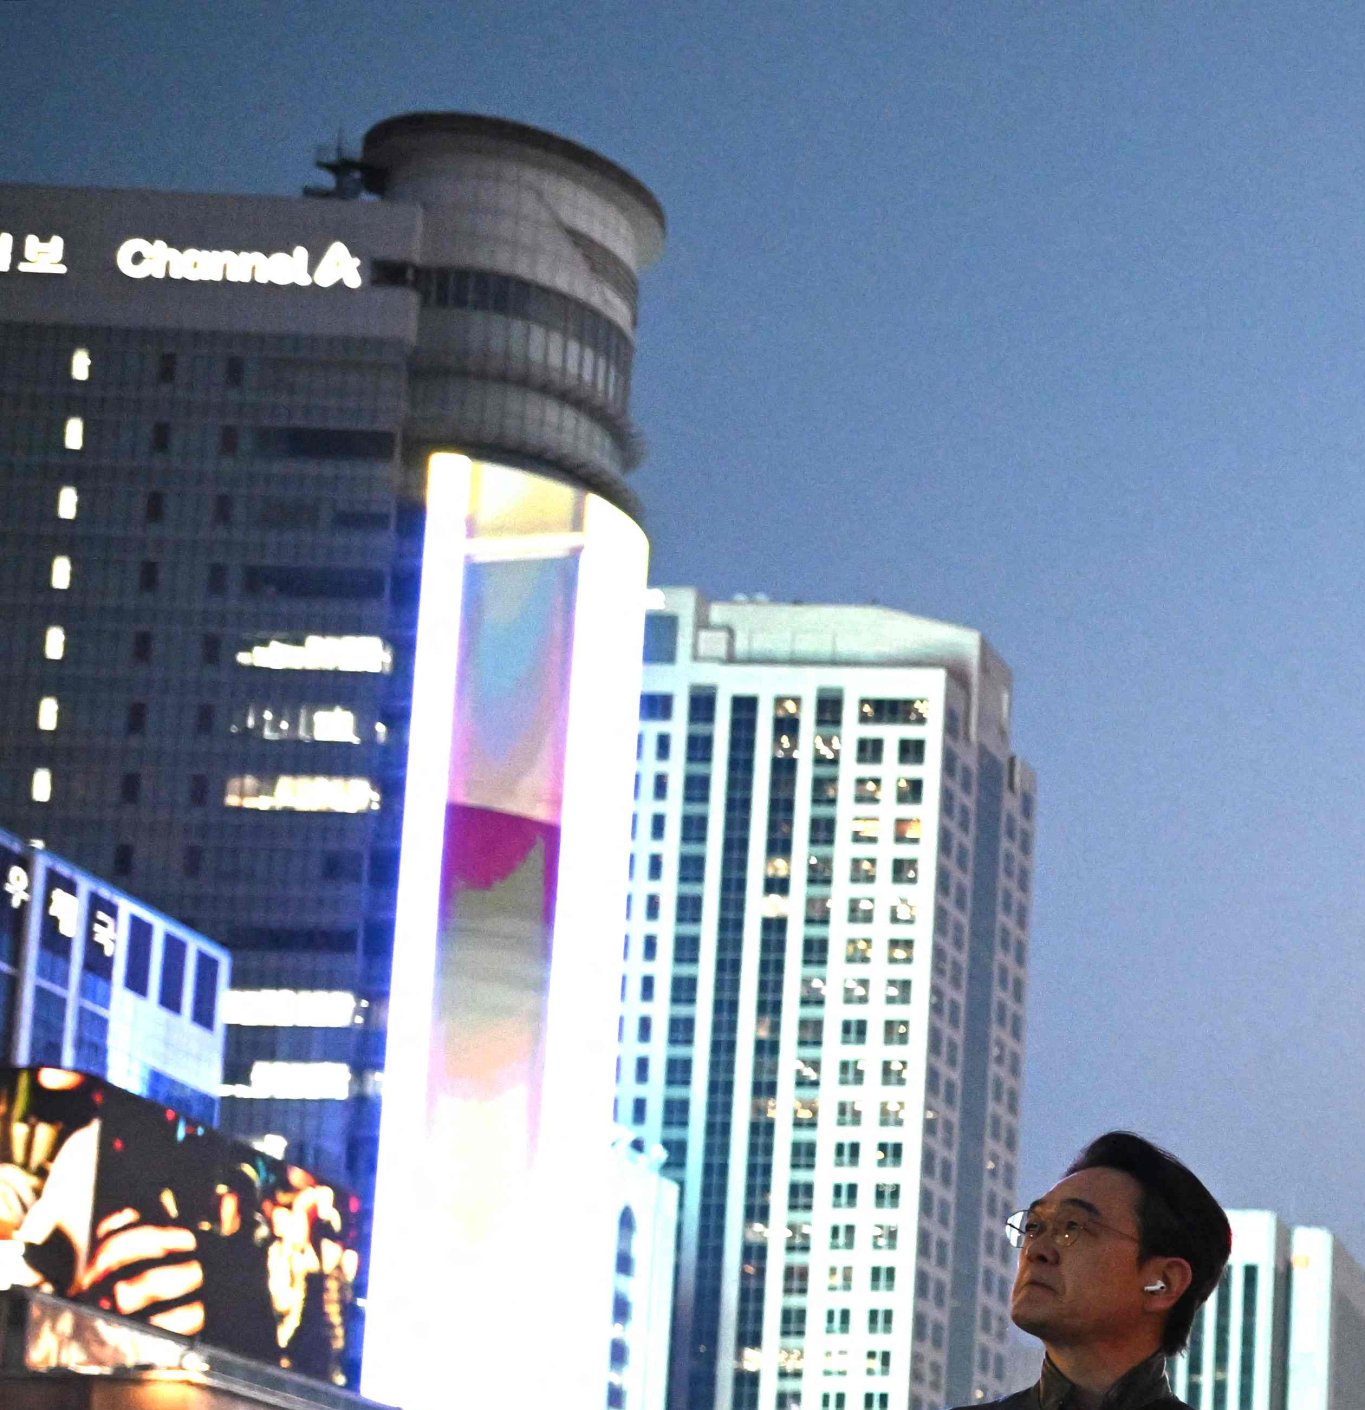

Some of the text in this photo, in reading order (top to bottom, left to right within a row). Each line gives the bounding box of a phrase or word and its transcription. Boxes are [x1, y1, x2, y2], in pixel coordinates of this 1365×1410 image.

[0, 232, 67, 274] 보
[116, 237, 312, 286] Channel
[4, 865, 116, 957] 우국
